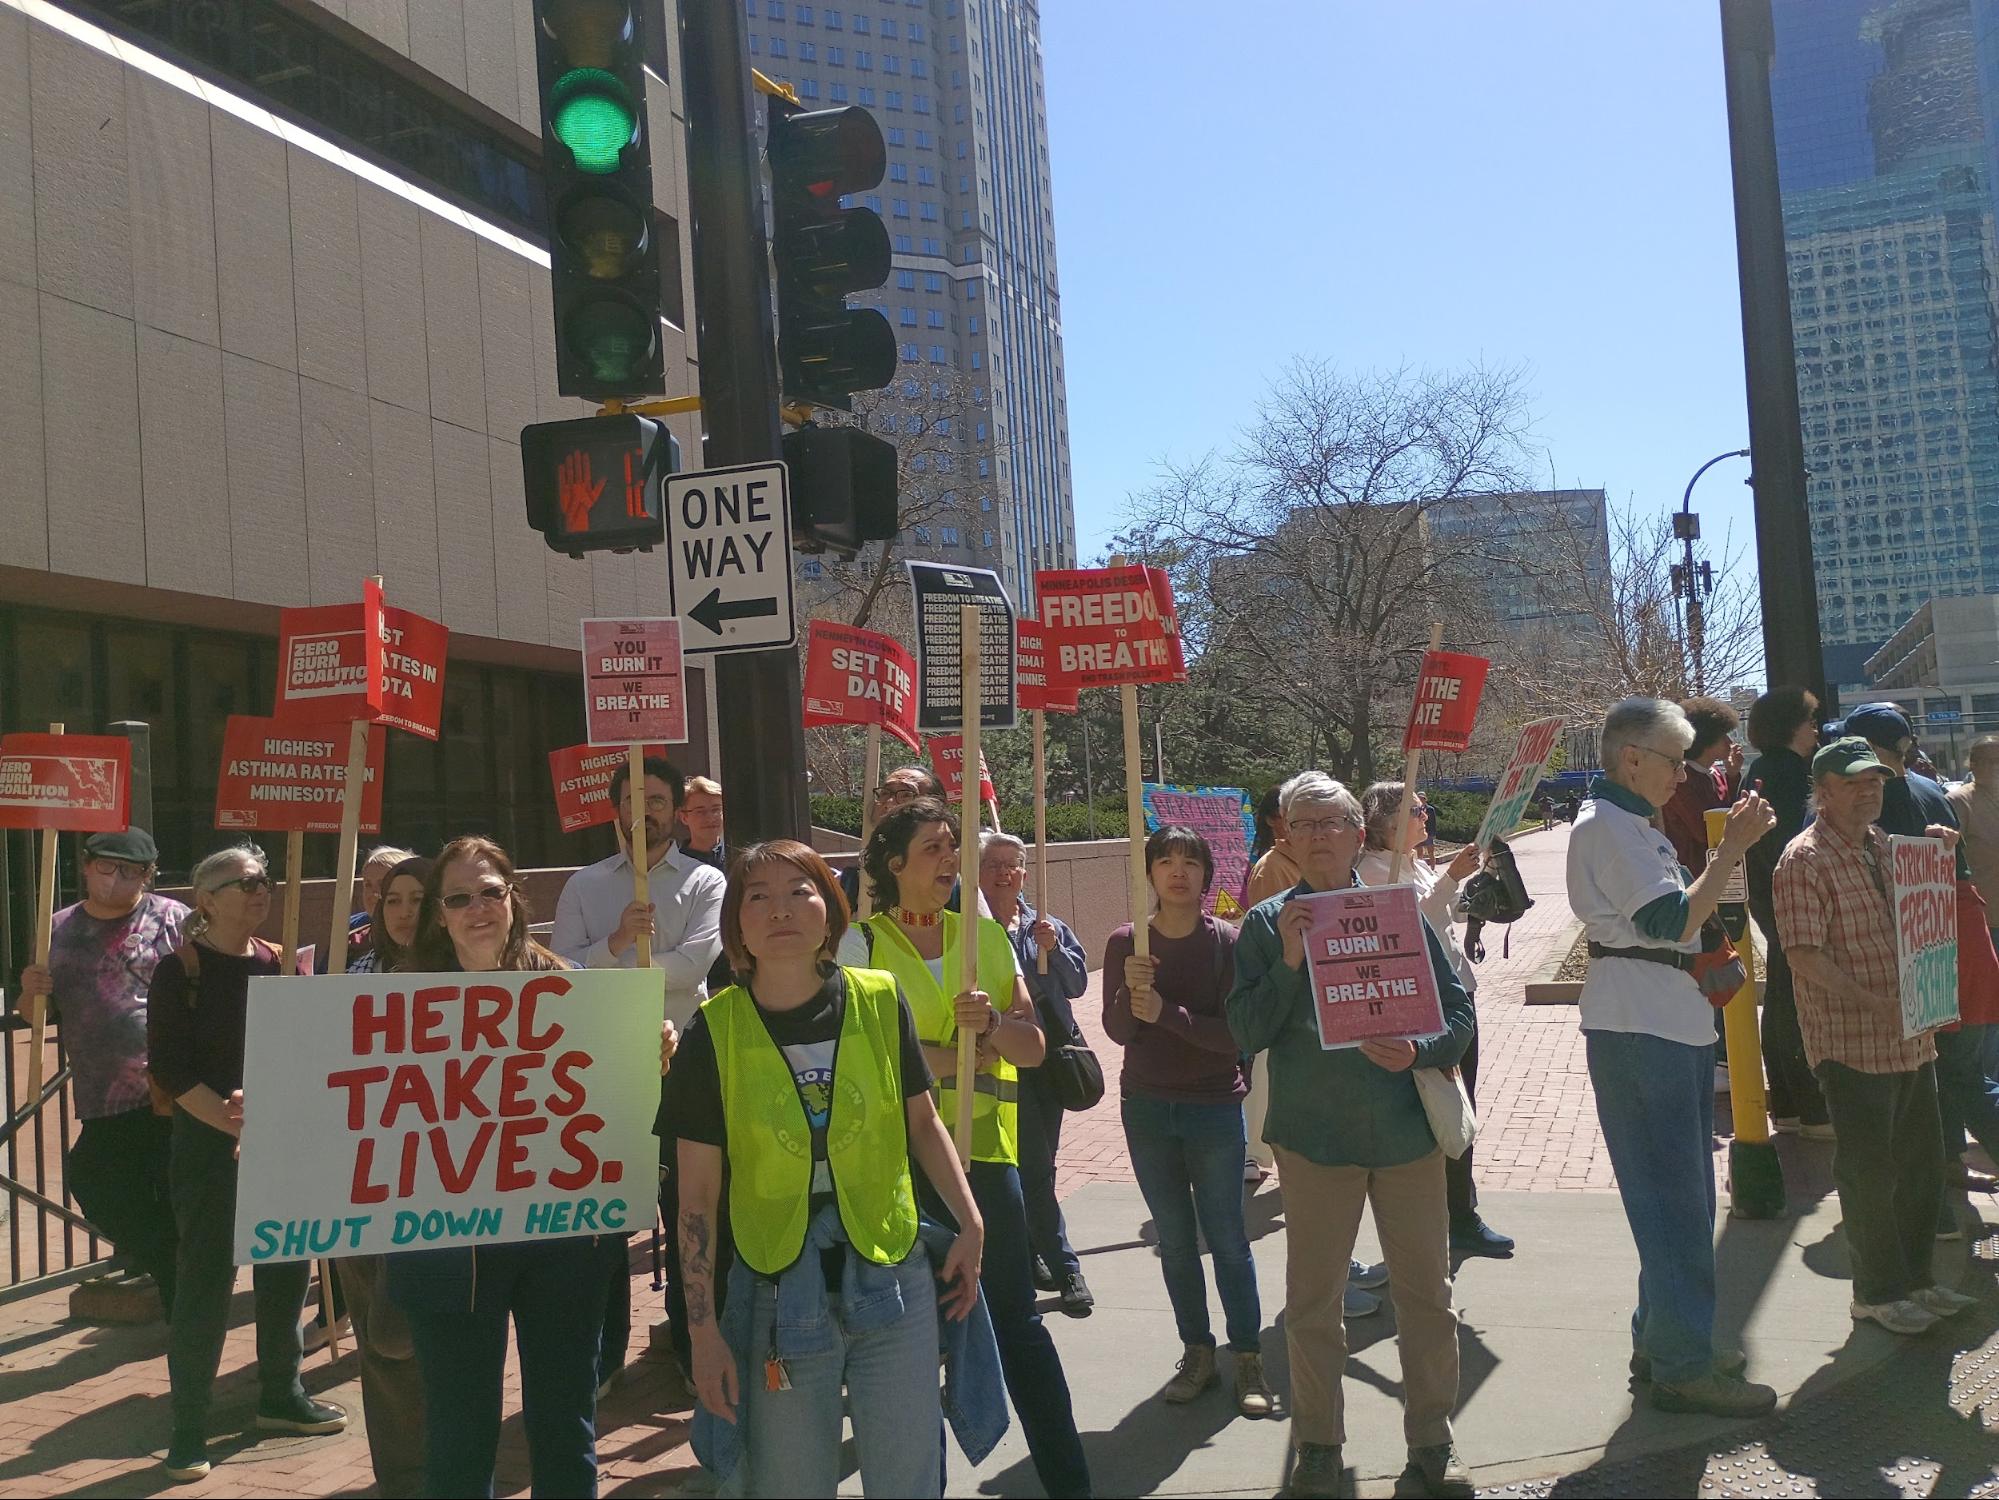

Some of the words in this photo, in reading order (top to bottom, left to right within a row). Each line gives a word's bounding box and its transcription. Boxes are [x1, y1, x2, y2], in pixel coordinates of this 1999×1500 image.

[682, 480, 771, 529] ONE
[682, 531, 773, 580] WAY
[923, 593, 959, 602] FREEDOM
[960, 594, 970, 603] TO
[971, 595, 1004, 604] BREATHE
[924, 604, 959, 612] FREEDOM
[979, 605, 1006, 614] REATHE
[1042, 590, 1159, 628] FREEDO
[924, 614, 960, 623] FREEDOM
[980, 614, 1008, 624] REATHE
[924, 625, 960, 634] FREEDOM
[980, 625, 1008, 634] REATHE
[1115, 629, 1127, 637] TO
[293, 640, 339, 657] ZERO
[614, 641, 646, 655] YOU
[925, 635, 960, 644] FREEDOM
[980, 635, 1008, 644] REATHE
[1020, 637, 1042, 650] HIGH
[926, 646, 960, 654] FREEDOM
[980, 646, 1008, 654] REATHE
[1059, 638, 1168, 672] BREATHE
[293, 654, 340, 671] BURN
[381, 648, 421, 677] ATES
[423, 664, 437, 683] IN
[601, 657, 645, 672] BURN
[648, 657, 662, 670] IT
[926, 656, 960, 665] FREEDOM
[980, 656, 1008, 664] REATHE
[291, 665, 367, 685] COALITIO
[831, 647, 880, 675] SET
[884, 659, 911, 698] THE
[927, 666, 960, 676] FREEDOM
[980, 666, 1008, 674] REATHE
[622, 681, 642, 693] WE
[927, 677, 960, 686] FREEDOM
[980, 676, 1008, 685] REATHE
[1430, 677, 1461, 700] THE
[847, 675, 903, 714] DATE
[927, 687, 960, 696] FREEDOM
[980, 686, 1008, 695] REATHE
[596, 695, 670, 711] BREATHE
[927, 698, 960, 707] FREEDOM
[980, 696, 1008, 705] REATHE
[629, 712, 641, 722] IT
[1415, 703, 1443, 725] ATE
[264, 739, 334, 758] HIGHEST
[1, 762, 32, 773] ZERO
[580, 751, 630, 771] HIGHEST
[228, 760, 297, 780] ASTHMA
[363, 767, 375, 782] N
[560, 772, 610, 794] ASTHMA
[250, 784, 345, 803] MINNESOTA
[1895, 843, 1938, 887] STRIKING
[1940, 855, 1956, 888] FOR
[1339, 916, 1378, 934] YOU
[1899, 889, 1956, 957] FREEDOM
[1326, 935, 1380, 956] BURN
[1383, 934, 1400, 950] IT
[1356, 965, 1380, 979] WE
[1325, 978, 1418, 1003] BREATHE
[352, 975, 573, 1055] HERC
[1368, 1001, 1383, 1016] IT
[327, 1050, 593, 1131] TAKES
[350, 1114, 624, 1204] LIVES.
[250, 1215, 372, 1260] SHUT
[390, 1207, 502, 1245] DOWN
[524, 1197, 627, 1235] HERC
